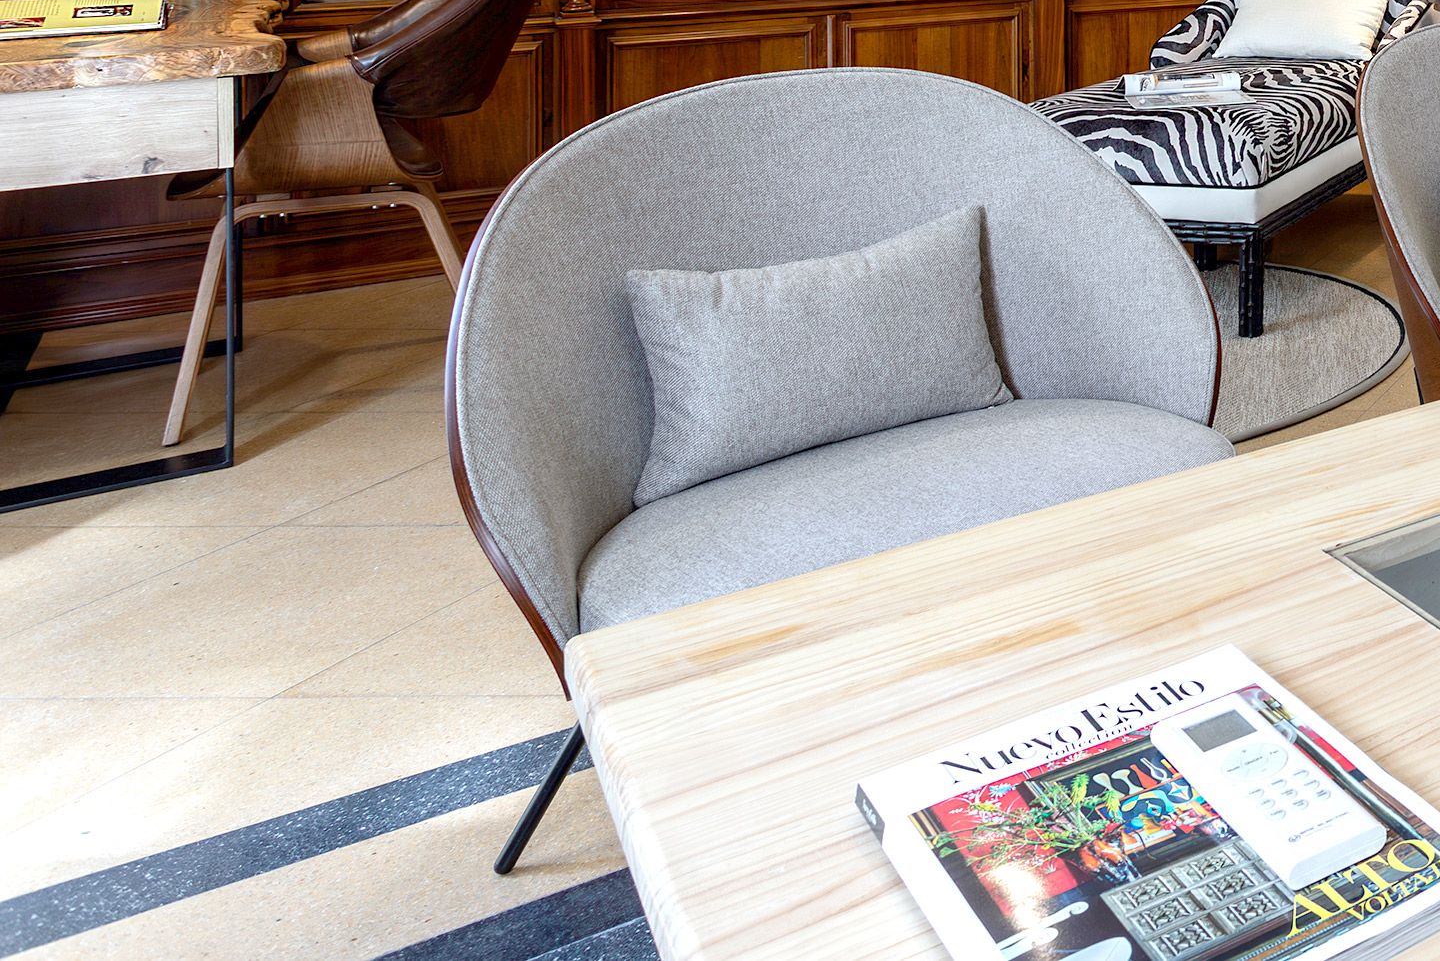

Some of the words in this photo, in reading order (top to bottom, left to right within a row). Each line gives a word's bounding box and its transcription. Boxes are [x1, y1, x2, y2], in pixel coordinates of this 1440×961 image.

[940, 725, 1082, 784] Nuevo
[1081, 679, 1205, 732] Estilo
[1045, 723, 1133, 760] collection
[1286, 839, 1436, 938] ALTO
